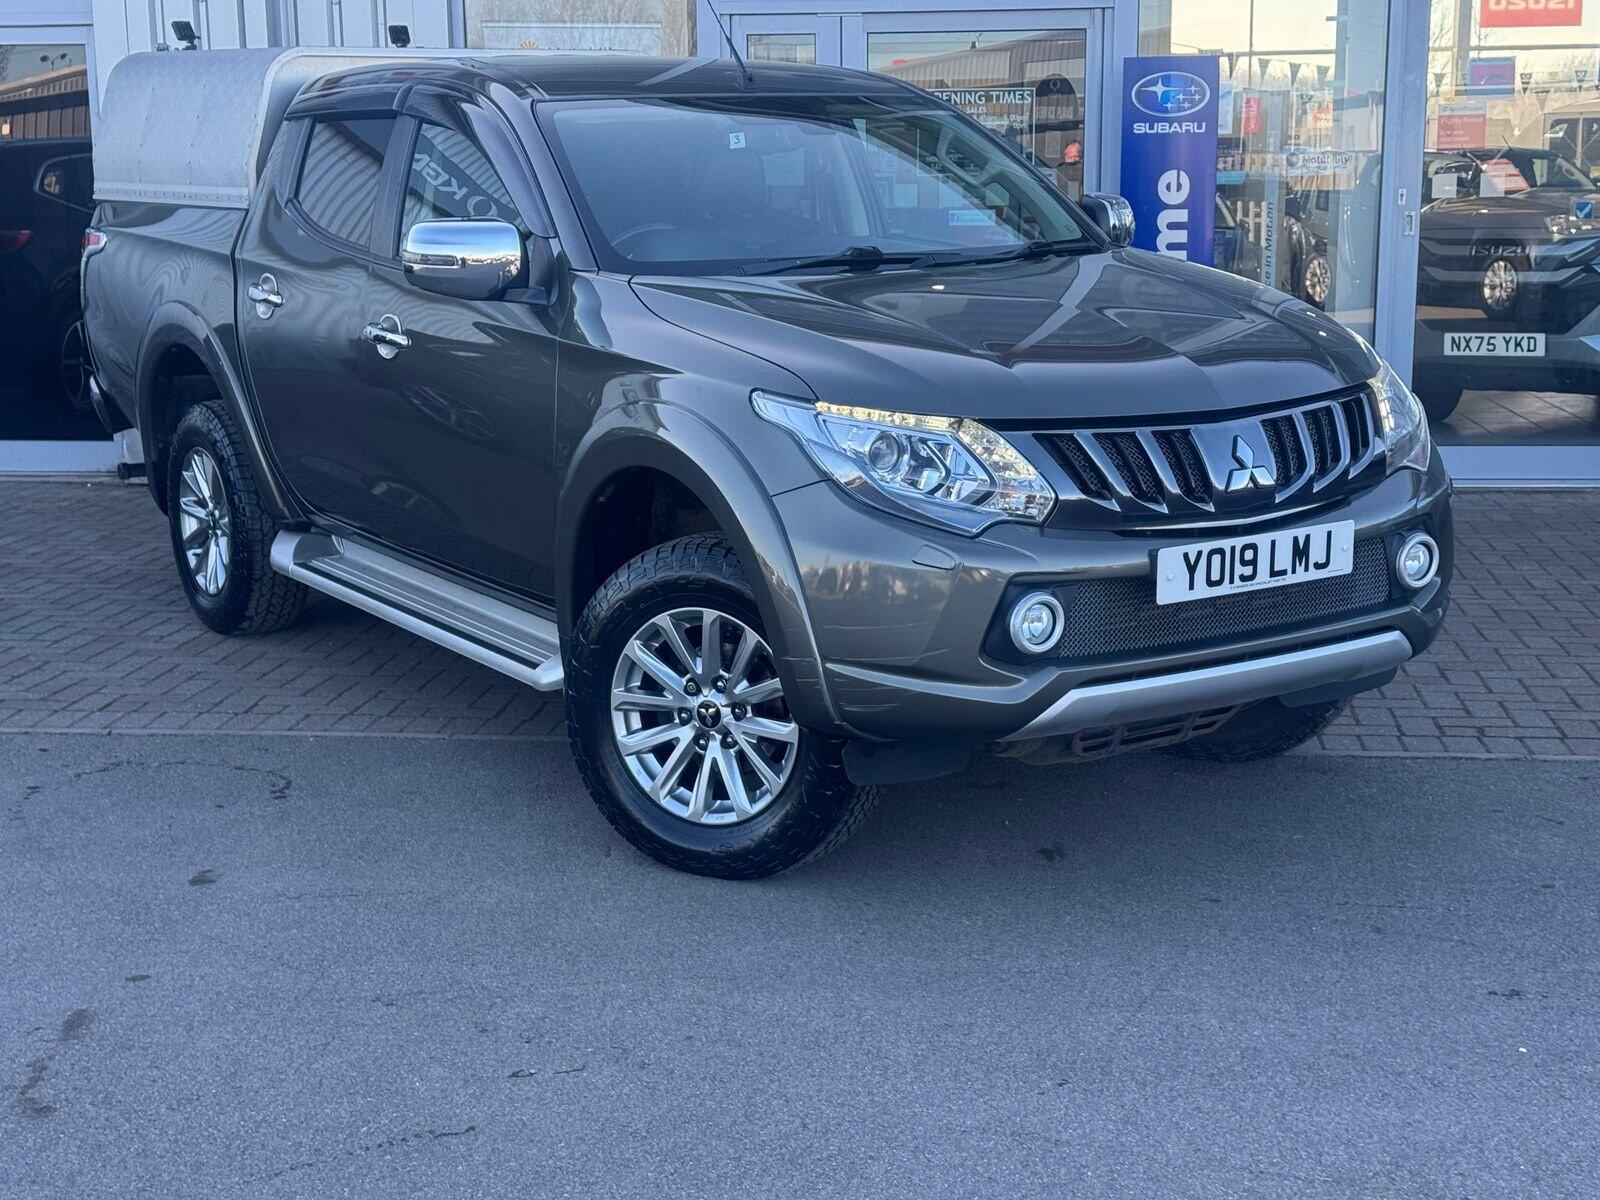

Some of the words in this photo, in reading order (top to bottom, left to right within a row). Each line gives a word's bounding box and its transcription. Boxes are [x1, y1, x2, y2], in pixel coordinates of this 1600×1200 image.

[989, 91, 1032, 104] TIMES
[1133, 122, 1206, 134] SUBARU
[1265, 202, 1274, 251] Motion
[1471, 245, 1530, 256] ISUZU
[1450, 335, 1497, 352] NX75
[1500, 335, 1538, 352] YKD
[1183, 542, 1259, 590] YO19
[1269, 530, 1332, 578] LMJ
